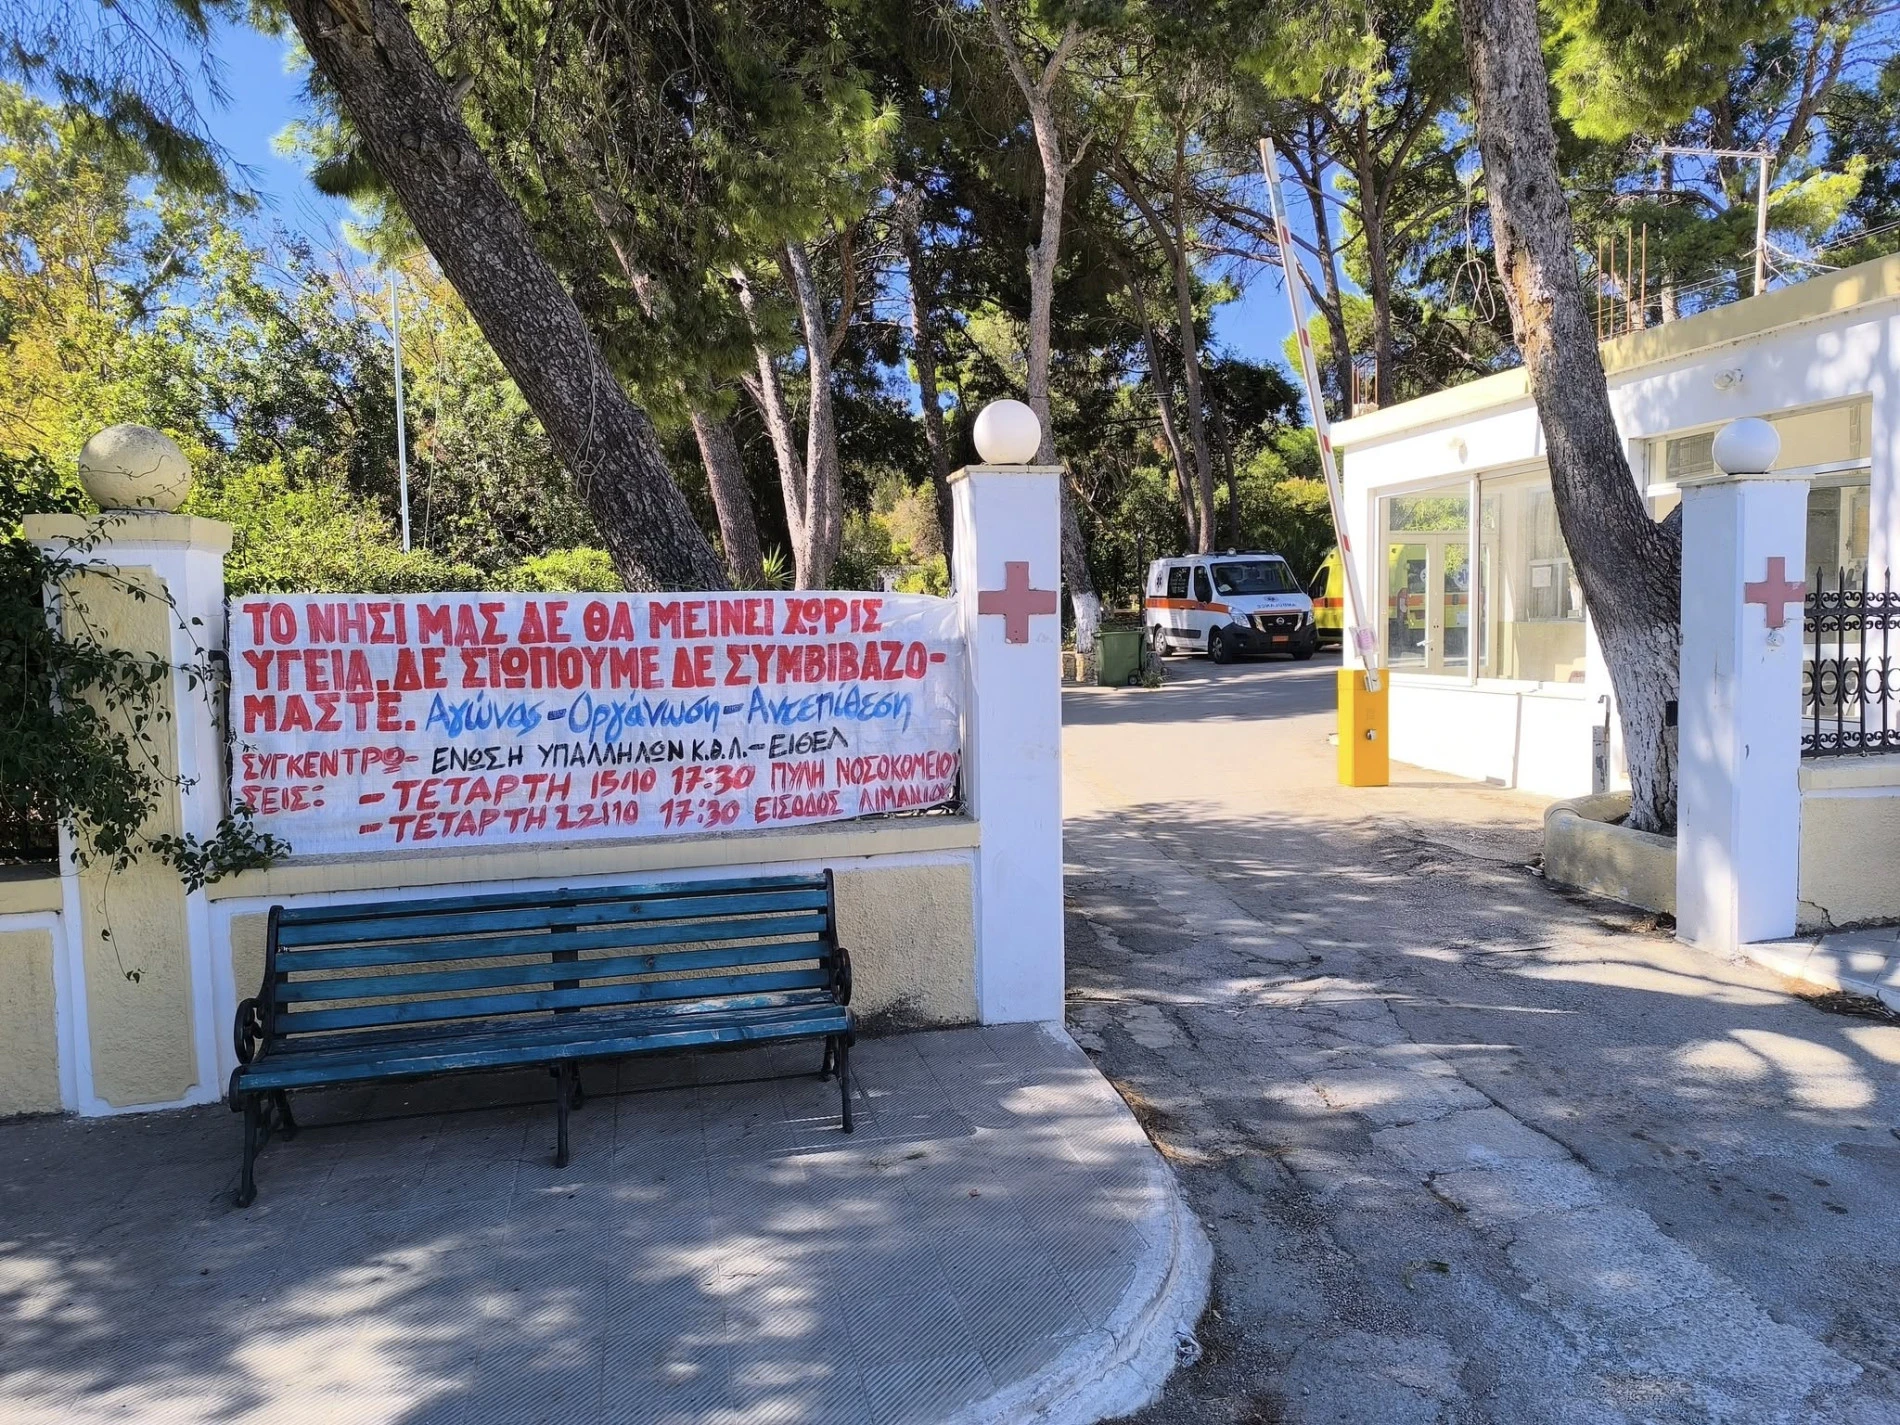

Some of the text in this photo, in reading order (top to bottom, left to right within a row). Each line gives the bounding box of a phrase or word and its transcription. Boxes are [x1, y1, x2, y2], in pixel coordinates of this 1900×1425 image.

[243, 597, 884, 646] ΤΟ ΝΗΣΙ ΜΑΣ ΔΕ ΘΑ ΜΕΙΝΕΙ ΧΩΡΙΣ
[392, 647, 449, 692] ΔΕ
[459, 645, 665, 690] ΣΙΩΠΟΥΜΕ
[671, 645, 717, 688] ΔΕ
[724, 641, 947, 686] ΣΥΜΒΙΒΑΖΟ-
[242, 693, 416, 733] ΜΑΣΤΕ.
[392, 772, 572, 812] ΤΕΤΑΡΤΗ
[671, 764, 757, 796] 17:30
[770, 758, 826, 794] ΠΥΛΗ
[836, 749, 960, 789] ΝΟΣΟΚΟΜΕΙΟΥ
[431, 745, 524, 775] ΕΝΩΣΗ
[538, 739, 684, 768] ΥΠΑΛΛΗΛΩΝ
[241, 785, 325, 815] ΣΕΙΣ:
[388, 804, 548, 844] ΤΕΤΑΡΤΗ
[658, 798, 741, 829] 17:30
[753, 788, 845, 824] ΕΙΣΟΔΟΣ
